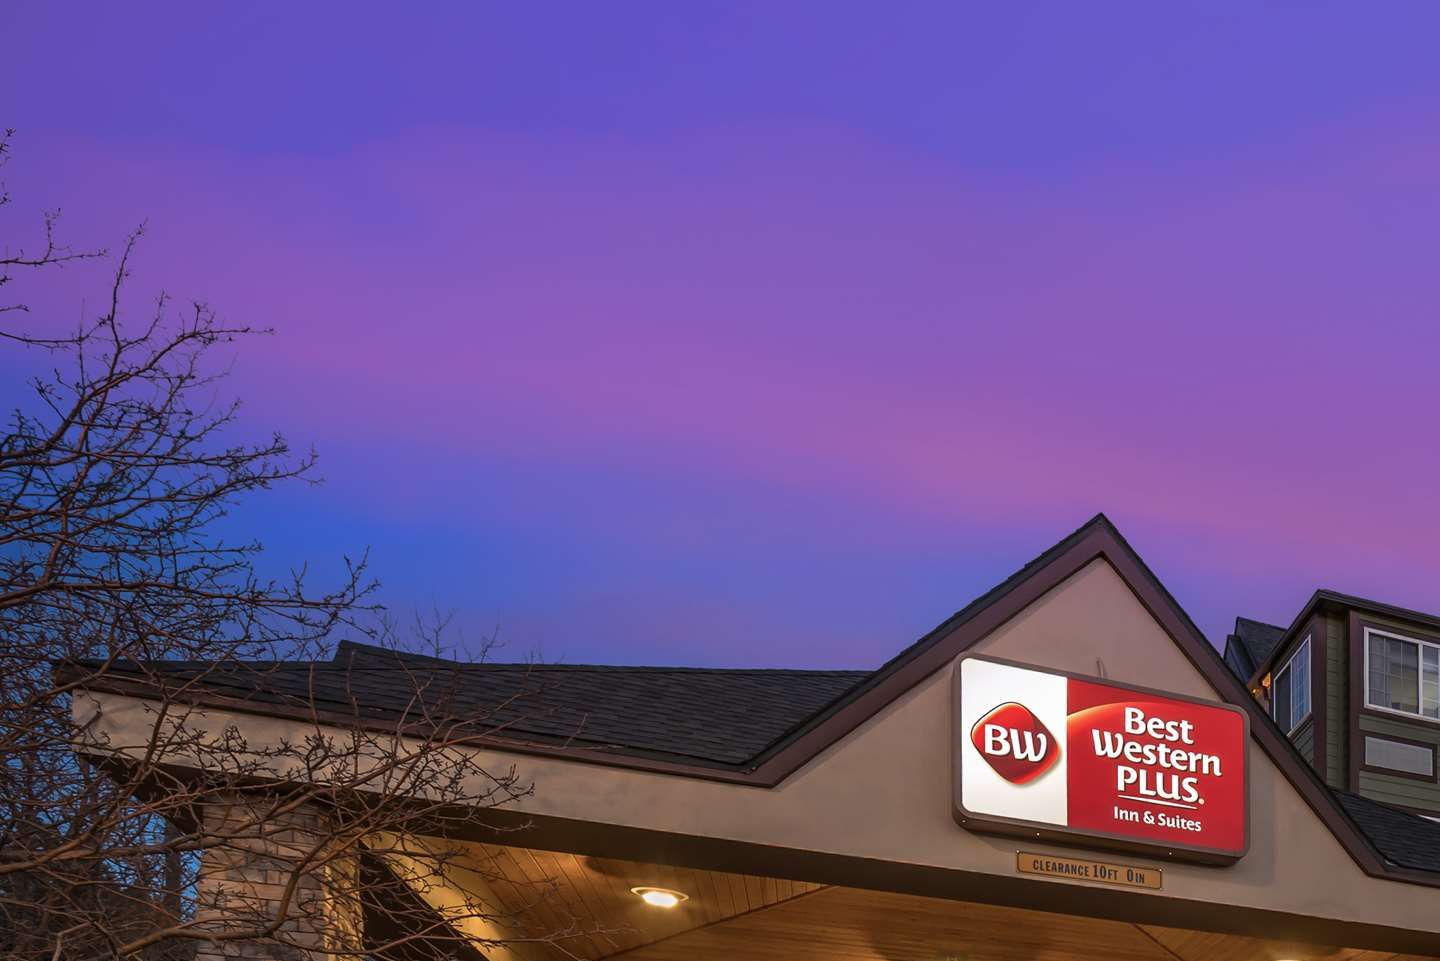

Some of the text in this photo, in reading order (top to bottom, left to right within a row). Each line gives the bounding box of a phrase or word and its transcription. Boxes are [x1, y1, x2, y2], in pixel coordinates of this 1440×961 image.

[984, 723, 1048, 762] BW
[1124, 707, 1194, 745] Best
[1091, 728, 1222, 776] Western
[1113, 805, 1202, 832] Inn & Suites
[1032, 859, 1090, 877] CLEARANCE
